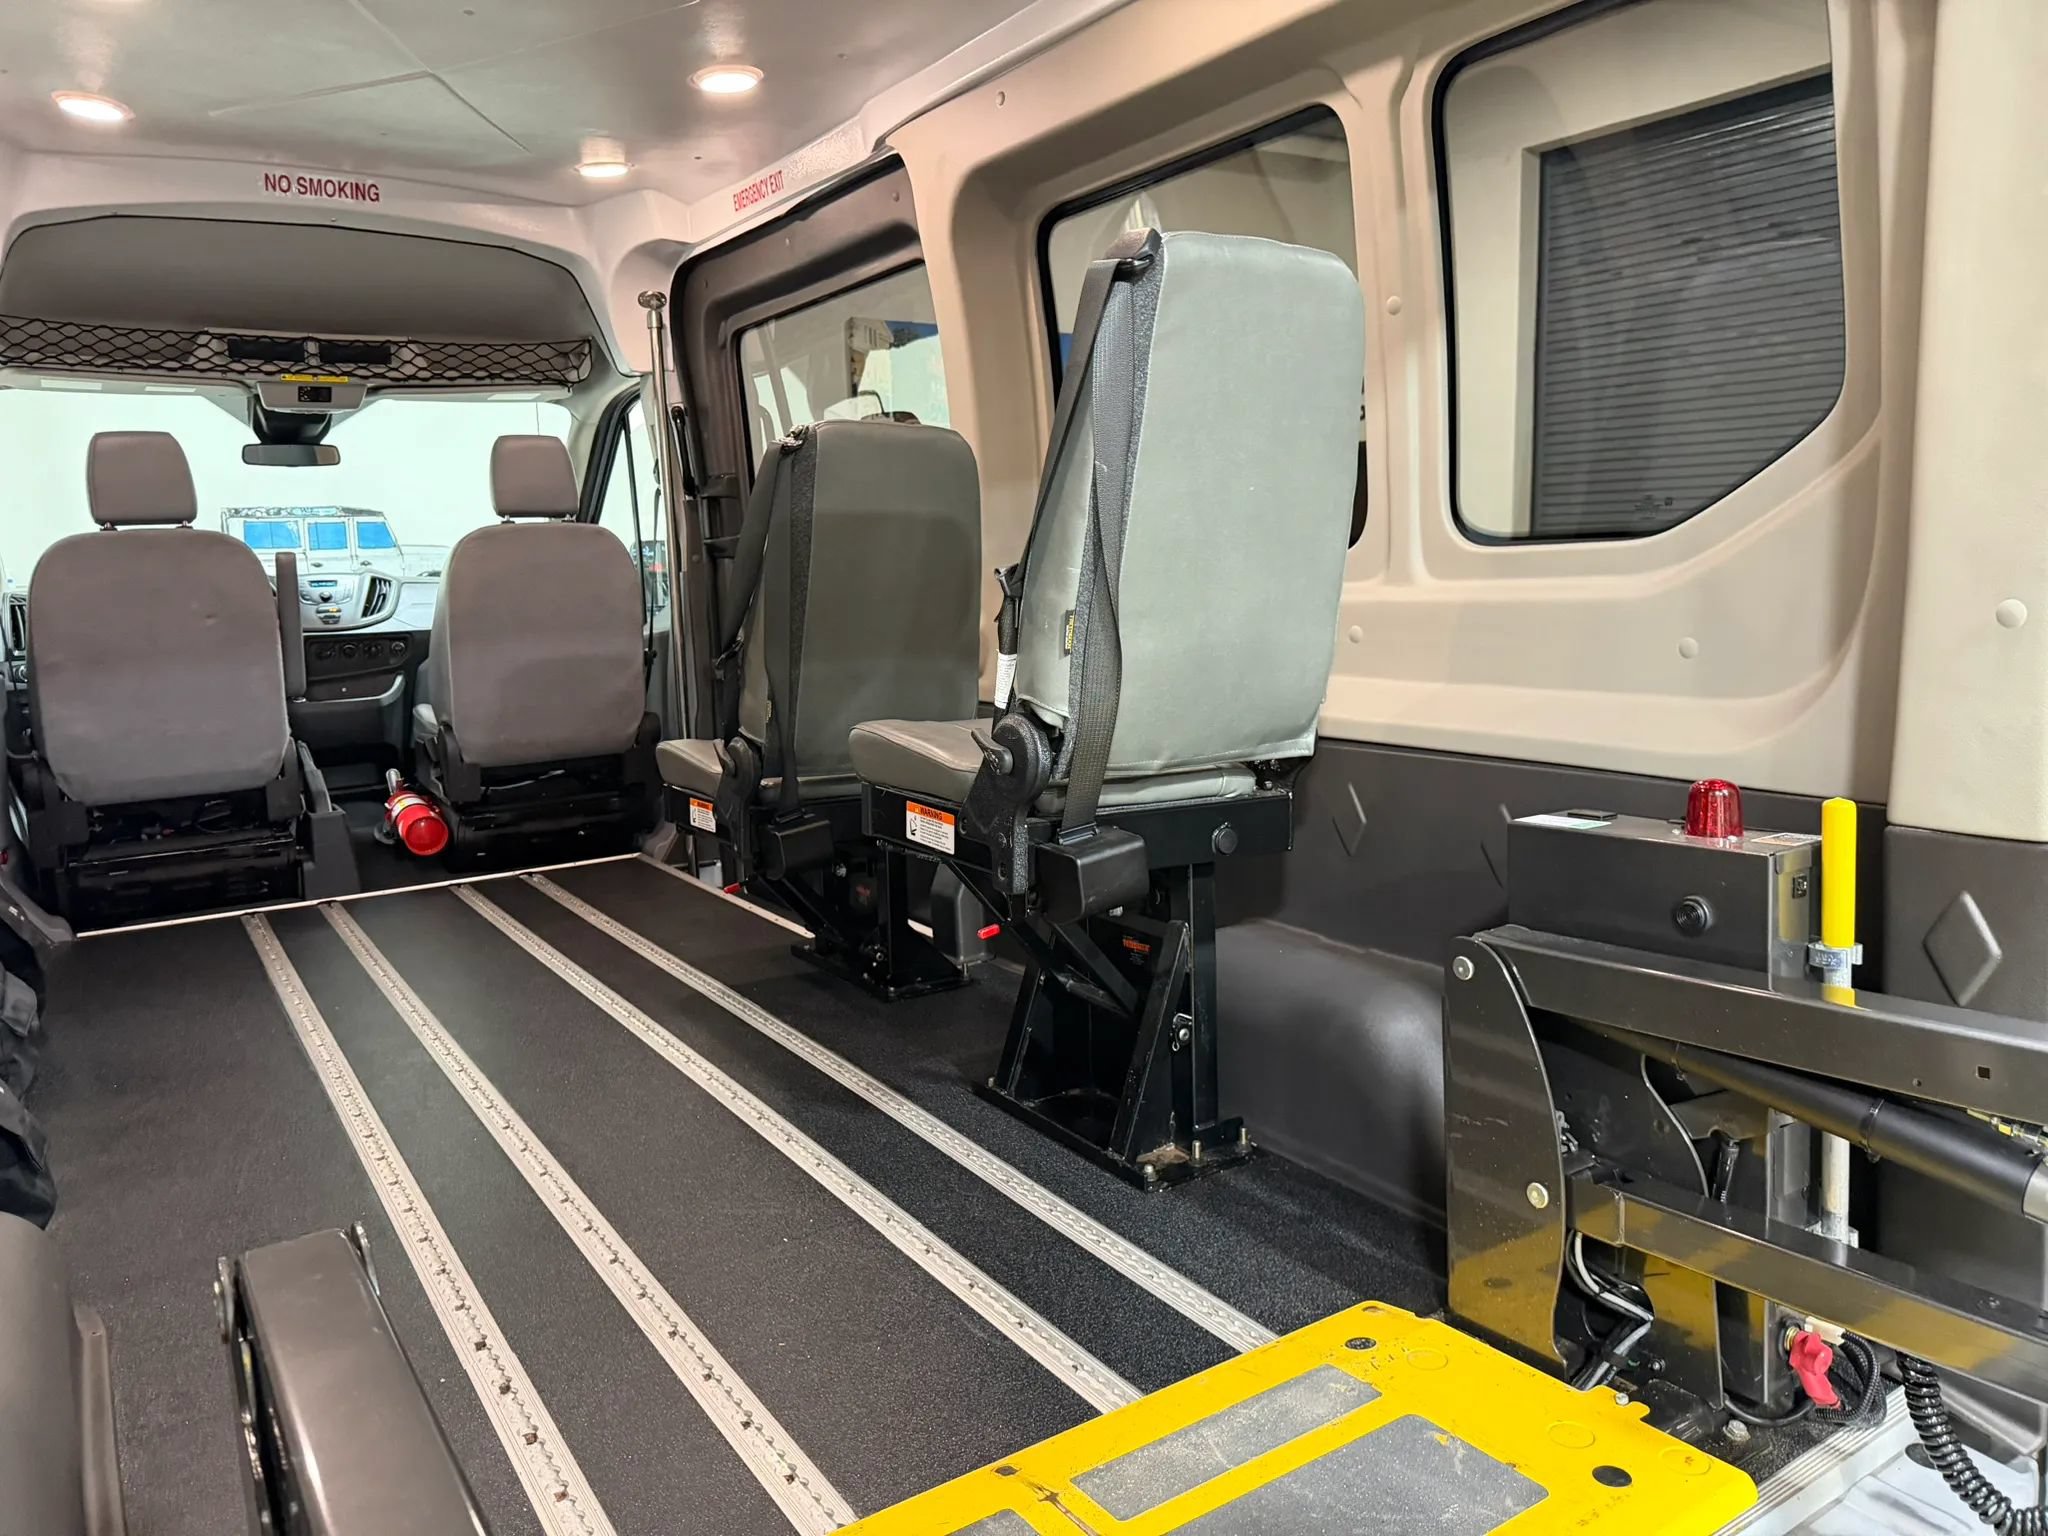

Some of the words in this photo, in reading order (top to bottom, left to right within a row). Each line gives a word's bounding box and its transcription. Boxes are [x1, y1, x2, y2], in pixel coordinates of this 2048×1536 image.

[264, 173, 291, 193] NO
[296, 176, 380, 202] SMOKING
[733, 177, 769, 212] EMERGENCY
[769, 170, 784, 194] EXIT
